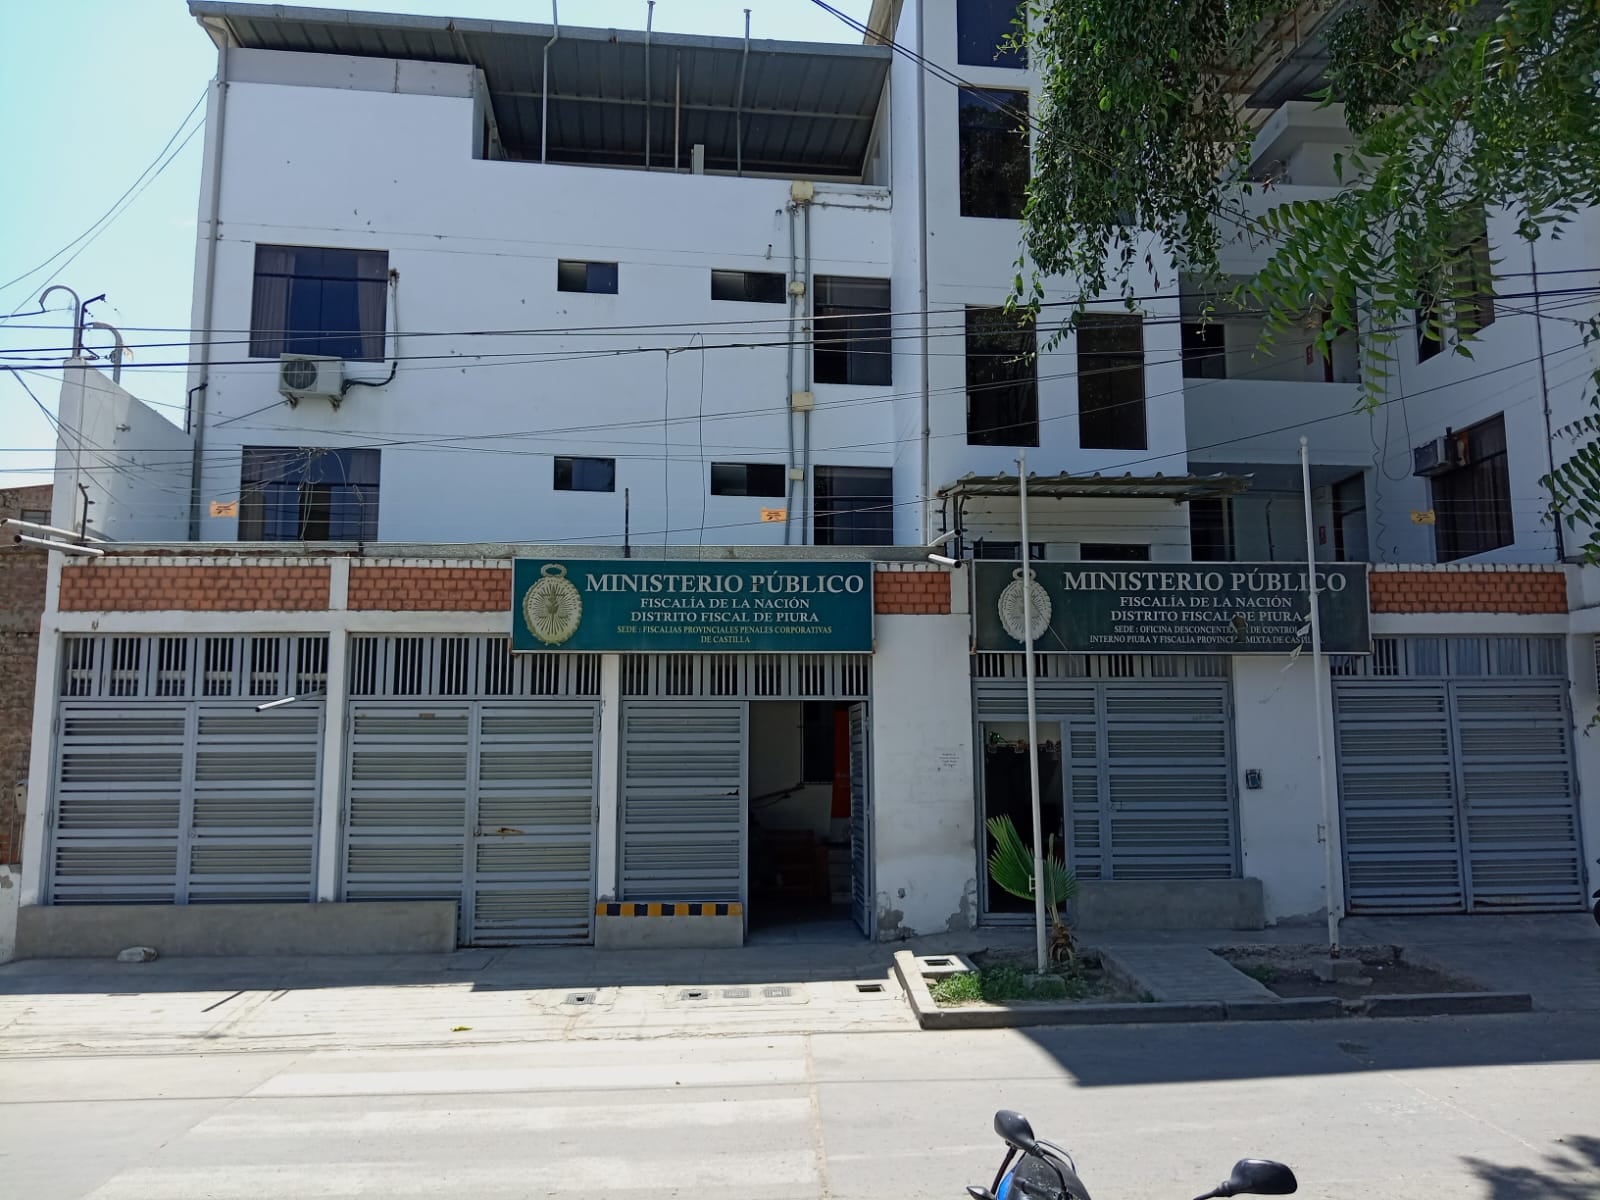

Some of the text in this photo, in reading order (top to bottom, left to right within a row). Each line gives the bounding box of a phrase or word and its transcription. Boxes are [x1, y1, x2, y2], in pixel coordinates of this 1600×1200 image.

[585, 570, 864, 593] MINISTERIO PÚBLICO
[1063, 567, 1347, 592] MINISTERIO PÚBLICO
[640, 595, 810, 609] FISCALÍA DE LA NACIÓN
[1119, 594, 1292, 608] FISCALÍA DE LA NACIÓN
[631, 611, 819, 622] DISTRITO FISCAL DE PIURA
[1111, 610, 1178, 621] DISTRITO
[1181, 611, 1231, 622] FISCAL
[1259, 611, 1303, 622] PIURA
[617, 625, 637, 633] SEDE
[642, 625, 682, 634] FISCALIAS
[683, 626, 739, 634] PROVINCIALES
[740, 626, 773, 634] PENALES
[774, 626, 833, 634] CORPORATIVAS
[1114, 625, 1134, 633] SEDE
[1140, 625, 1172, 633] OFICINA
[1250, 625, 1260, 634] DE
[700, 635, 751, 644] DE CASTILLA
[1090, 634, 1126, 643] INTERNO
[1126, 635, 1152, 643] PIURA
[1152, 635, 1159, 643] Y
[1159, 633, 1195, 644] FISCALÍA
[1272, 636, 1283, 644] DE
